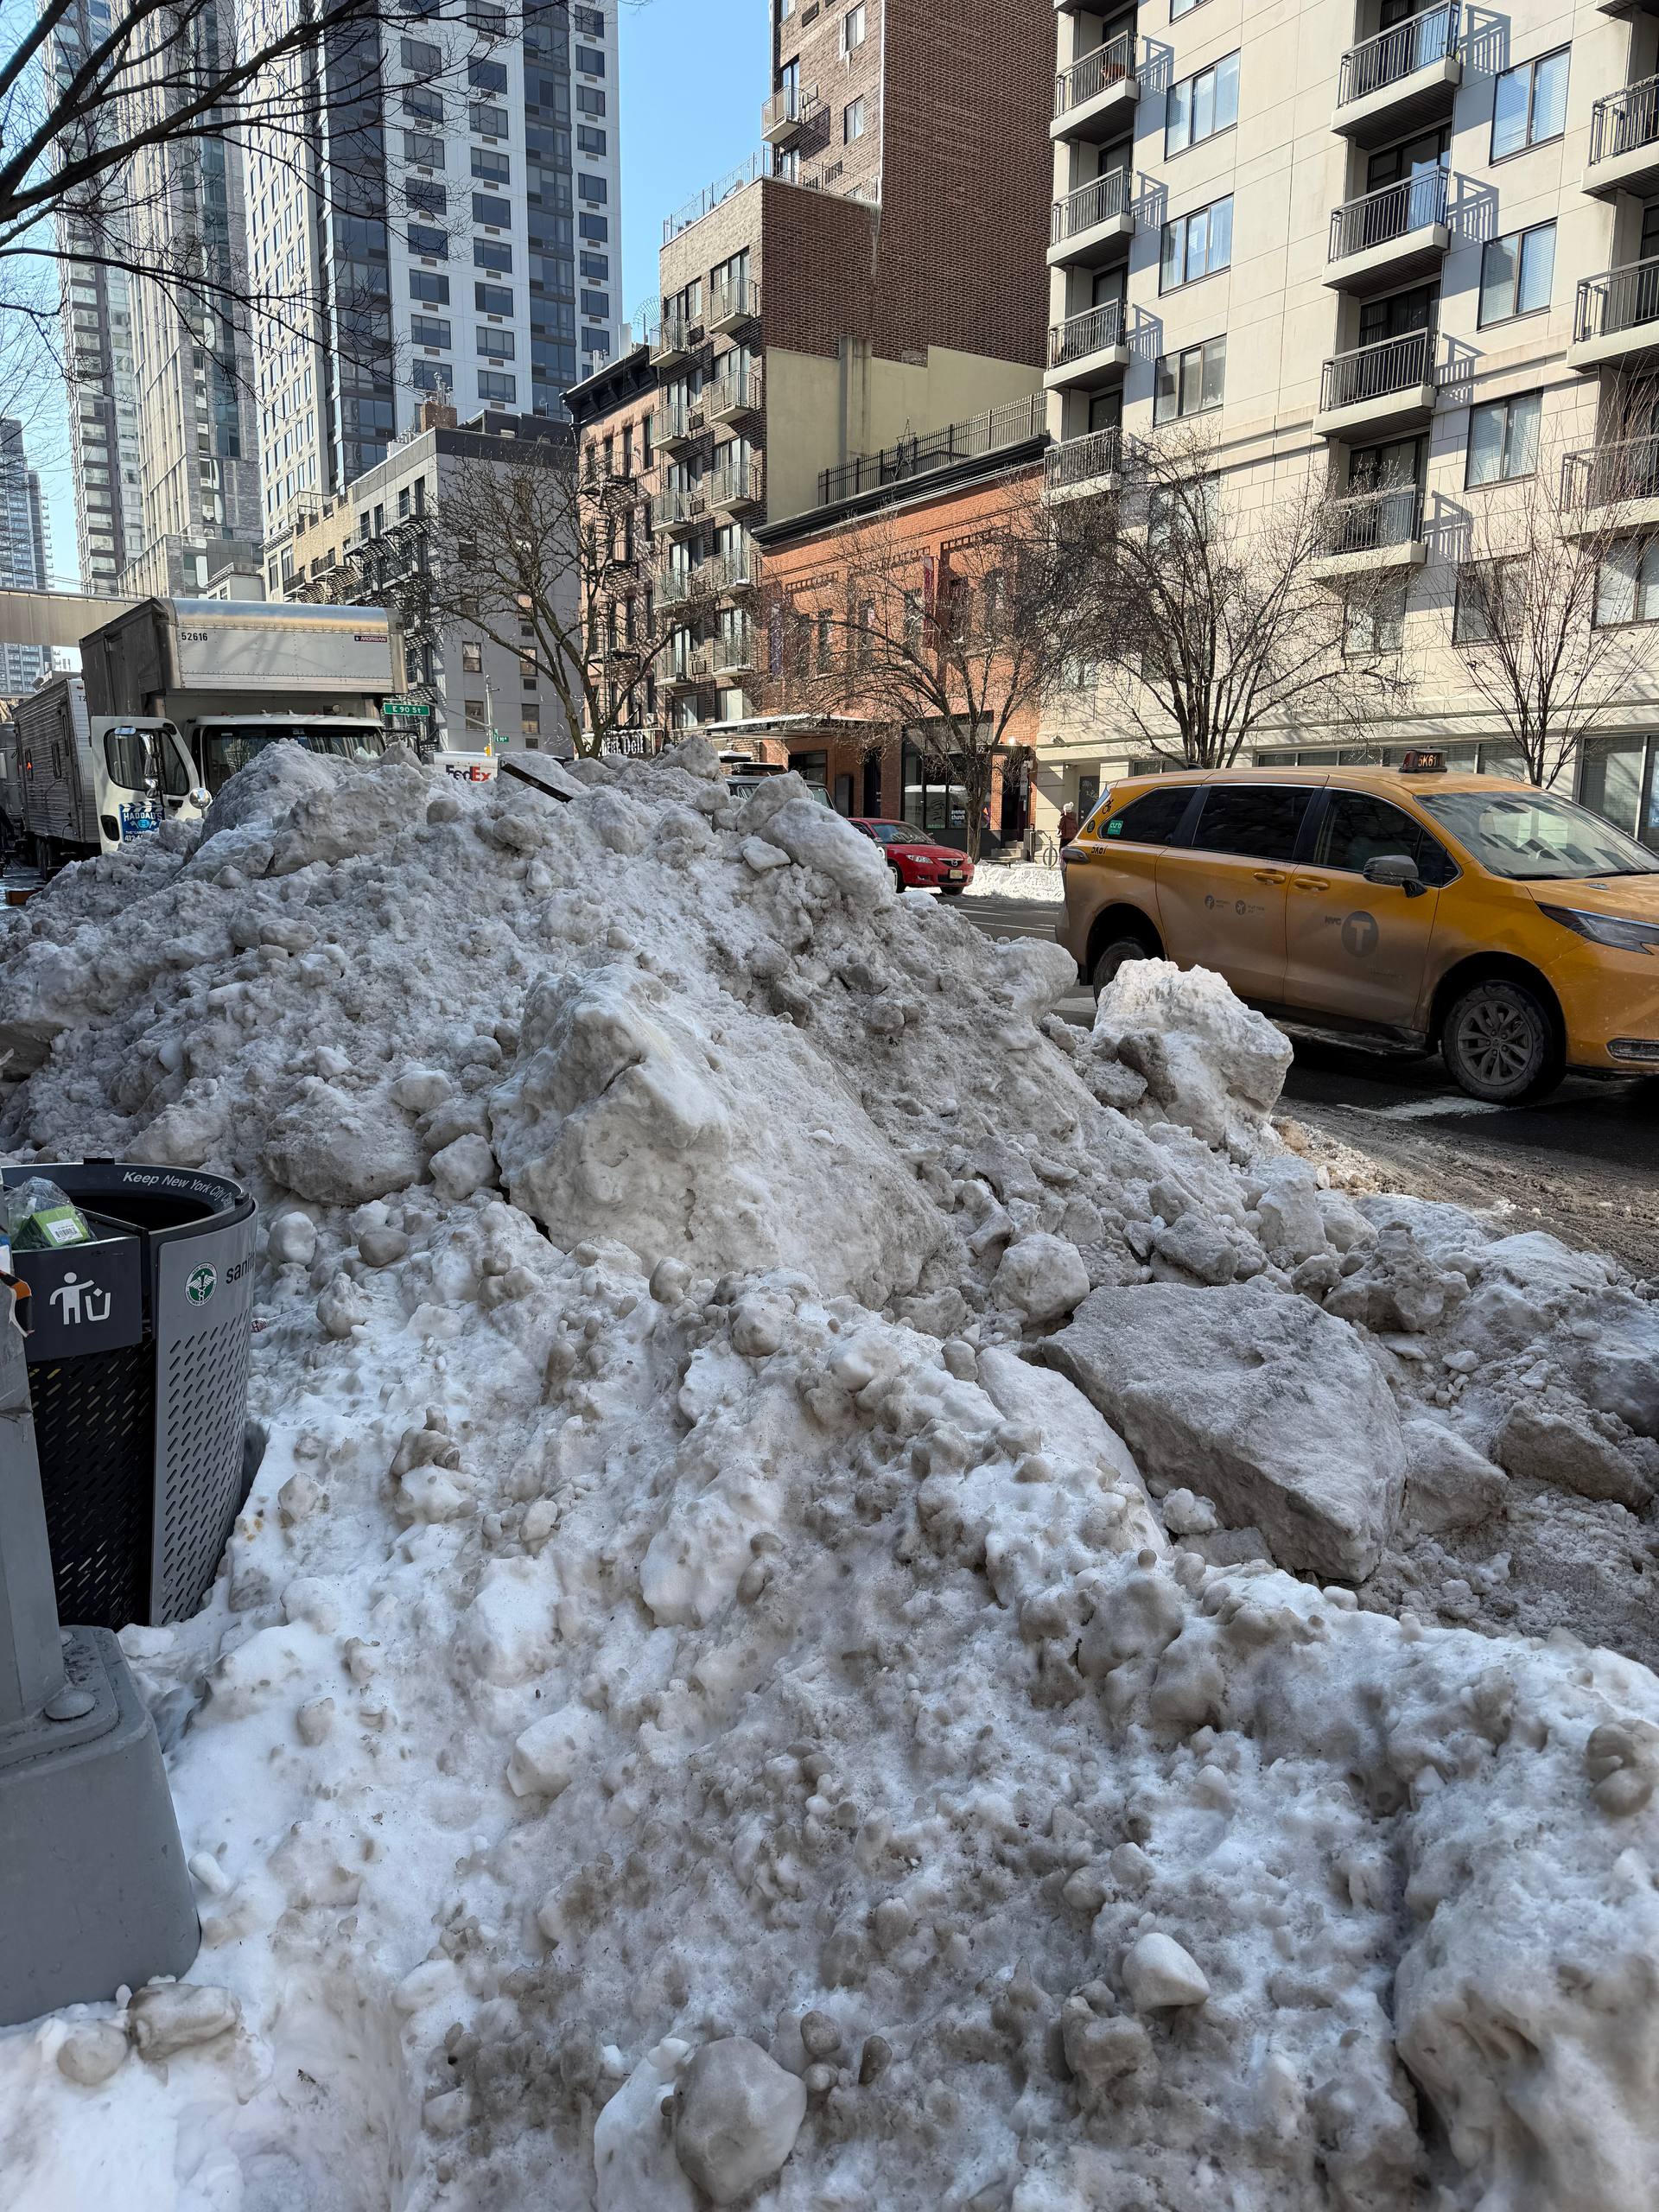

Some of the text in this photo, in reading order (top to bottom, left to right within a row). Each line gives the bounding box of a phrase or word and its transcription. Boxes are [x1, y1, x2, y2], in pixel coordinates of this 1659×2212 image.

[181, 632, 208, 641] 52616
[623, 732, 644, 755] Deli
[1418, 754, 1438, 767] 5K61
[446, 765, 491, 781] FedEx
[124, 812, 162, 822] HADDAD'S
[1324, 916, 1341, 925] NYC
[1351, 919, 1371, 951] T
[123, 1172, 159, 1186] Keep
[162, 1174, 189, 1188] New
[190, 1179, 212, 1193] York
[209, 1185, 224, 1201] City
